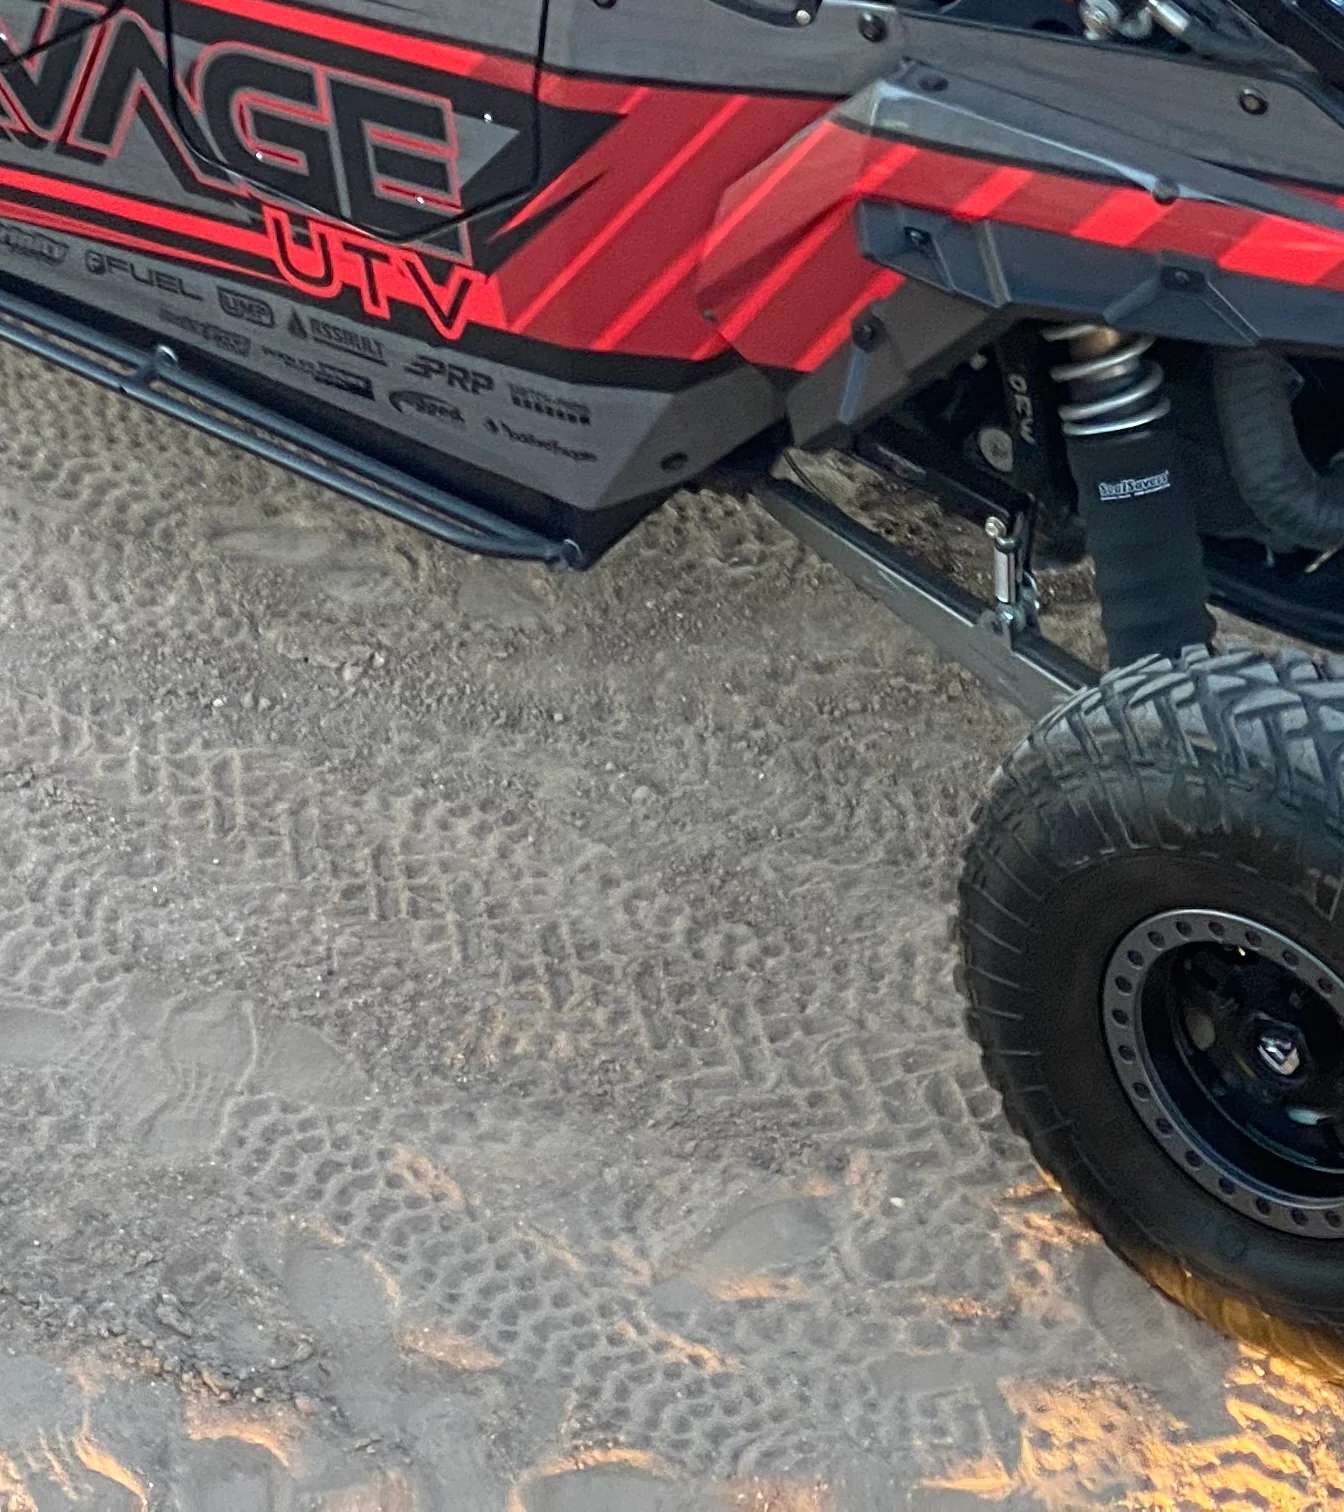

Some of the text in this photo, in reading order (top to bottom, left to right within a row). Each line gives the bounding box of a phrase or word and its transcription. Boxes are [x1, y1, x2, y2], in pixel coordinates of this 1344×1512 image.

[106, 253, 204, 301] FUEL
[263, 204, 486, 341] UTV
[406, 354, 495, 395] PRP
